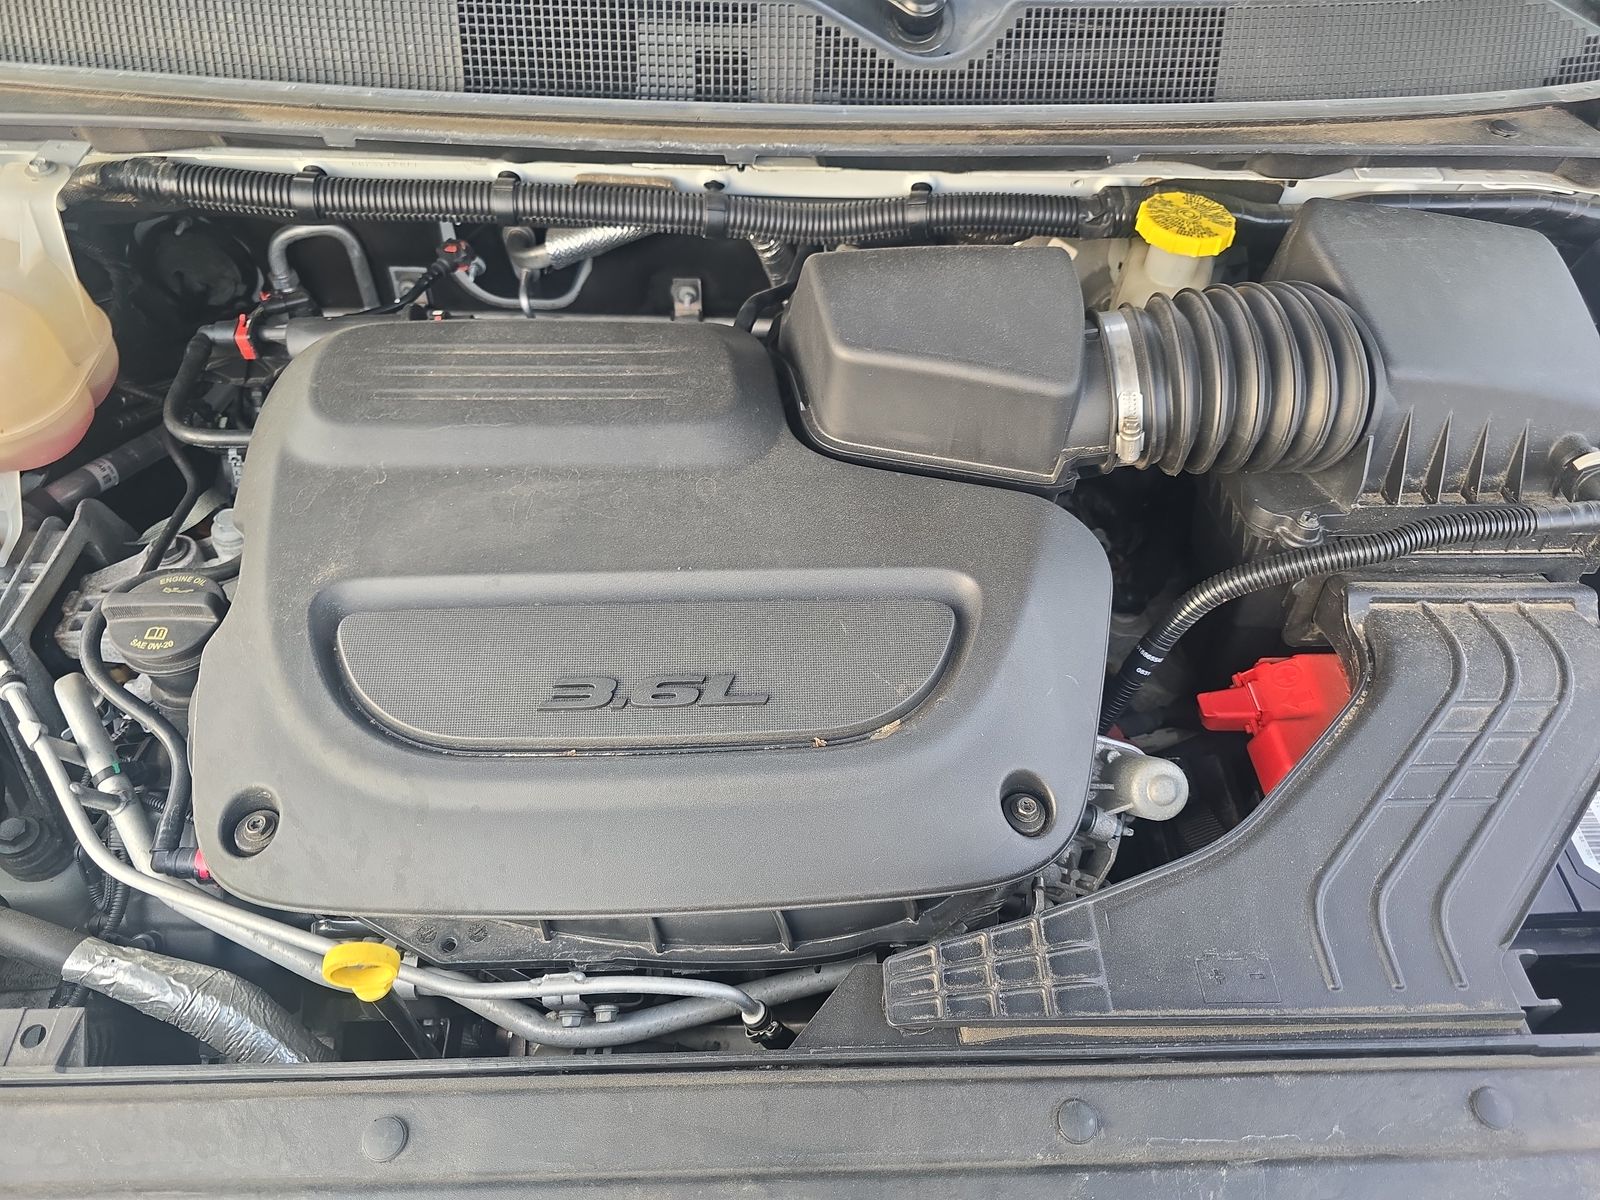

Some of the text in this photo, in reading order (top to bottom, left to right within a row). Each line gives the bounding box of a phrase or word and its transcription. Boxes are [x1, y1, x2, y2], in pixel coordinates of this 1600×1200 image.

[160, 575, 206, 586] ENGINE OIL
[130, 639, 174, 650] SAE 0W-20
[537, 674, 769, 711] 3.6L
